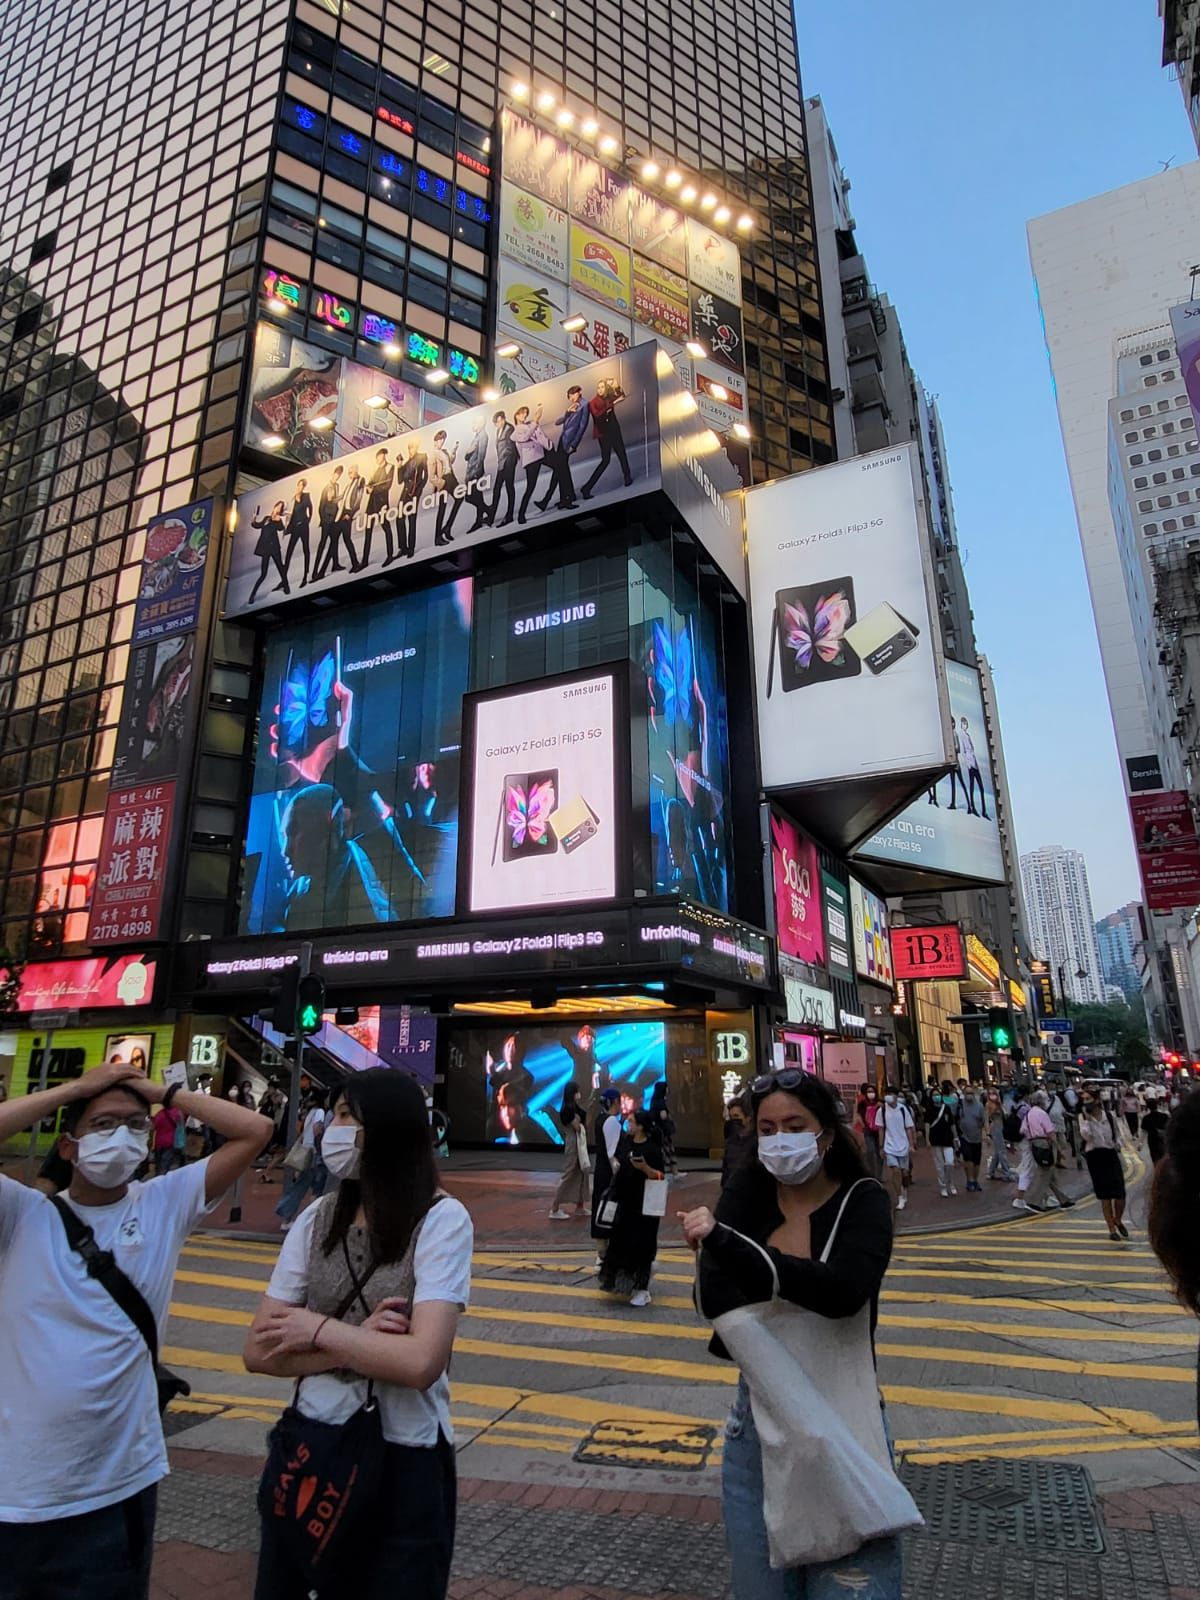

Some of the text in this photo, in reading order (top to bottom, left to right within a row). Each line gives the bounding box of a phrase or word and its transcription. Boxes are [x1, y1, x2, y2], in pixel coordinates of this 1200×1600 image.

[547, 206, 565, 224] 7/F
[727, 375, 741, 388] 6/F
[861, 455, 902, 472] SAMSUNG
[422, 490, 449, 510] an
[453, 474, 491, 499] era
[684, 455, 730, 526] AMSUNG
[777, 518, 884, 552] Galaxy Z Fold3 Flip3 5G
[514, 602, 596, 636] SAMSUNG
[347, 648, 416, 673] Galaxy Z Fold3 5G
[563, 682, 607, 699] SAMSUNG
[486, 729, 602, 758] Galaxy Z Fold3 Flip3 5G
[144, 787, 163, 801] 4/F
[112, 806, 164, 847] 麻辣
[898, 820, 914, 834] an
[915, 824, 935, 839] era
[107, 845, 160, 886] 派對
[92, 920, 152, 940] 2178 4898
[641, 925, 682, 941] Unfold
[682, 929, 690, 941] an
[323, 949, 389, 965] Unfold an era
[416, 931, 604, 958] SAMSUNG Galaxy Z Fold3 Flip3 5G
[905, 934, 943, 966] iB
[27, 1037, 86, 1079] izzue
[418, 1040, 431, 1052] 3F
[716, 1032, 749, 1063] iB
[307, 1481, 341, 1538] BOY
